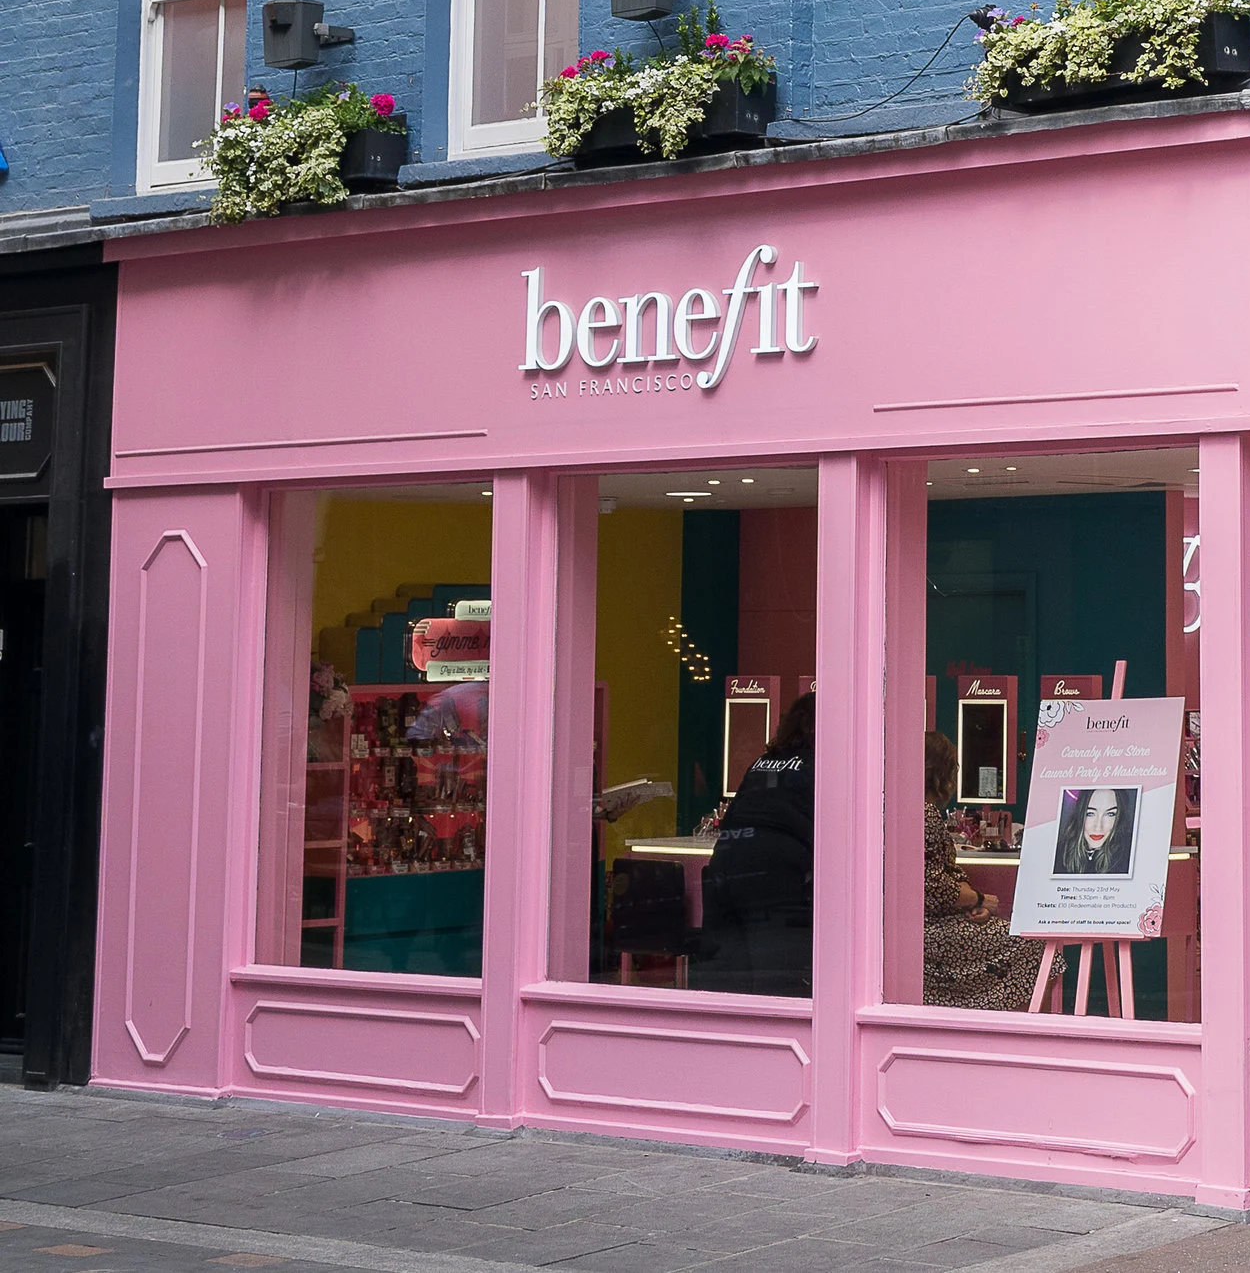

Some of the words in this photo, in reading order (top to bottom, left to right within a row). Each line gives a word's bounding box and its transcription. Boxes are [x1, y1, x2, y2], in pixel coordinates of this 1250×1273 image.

[518, 244, 819, 389] benefit
[531, 382, 567, 401] SAN
[579, 373, 693, 396] FRANCISCO
[0, 400, 26, 420] YING
[1, 422, 25, 441] OUR
[468, 604, 491, 616] benef
[430, 632, 478, 657] gimme
[730, 679, 766, 695] Foundation
[966, 680, 1001, 696] Mascara
[1053, 680, 1080, 696] Brows
[1086, 715, 1130, 732] benefit
[1061, 744, 1101, 763] Carnaby
[1103, 745, 1124, 757] New
[1125, 744, 1152, 757] Store
[751, 756, 804, 772] benefit
[1040, 765, 1074, 779] Launch
[1074, 765, 1101, 783] Party
[1103, 766, 1113, 778] &
[1112, 764, 1168, 779] Masterclass
